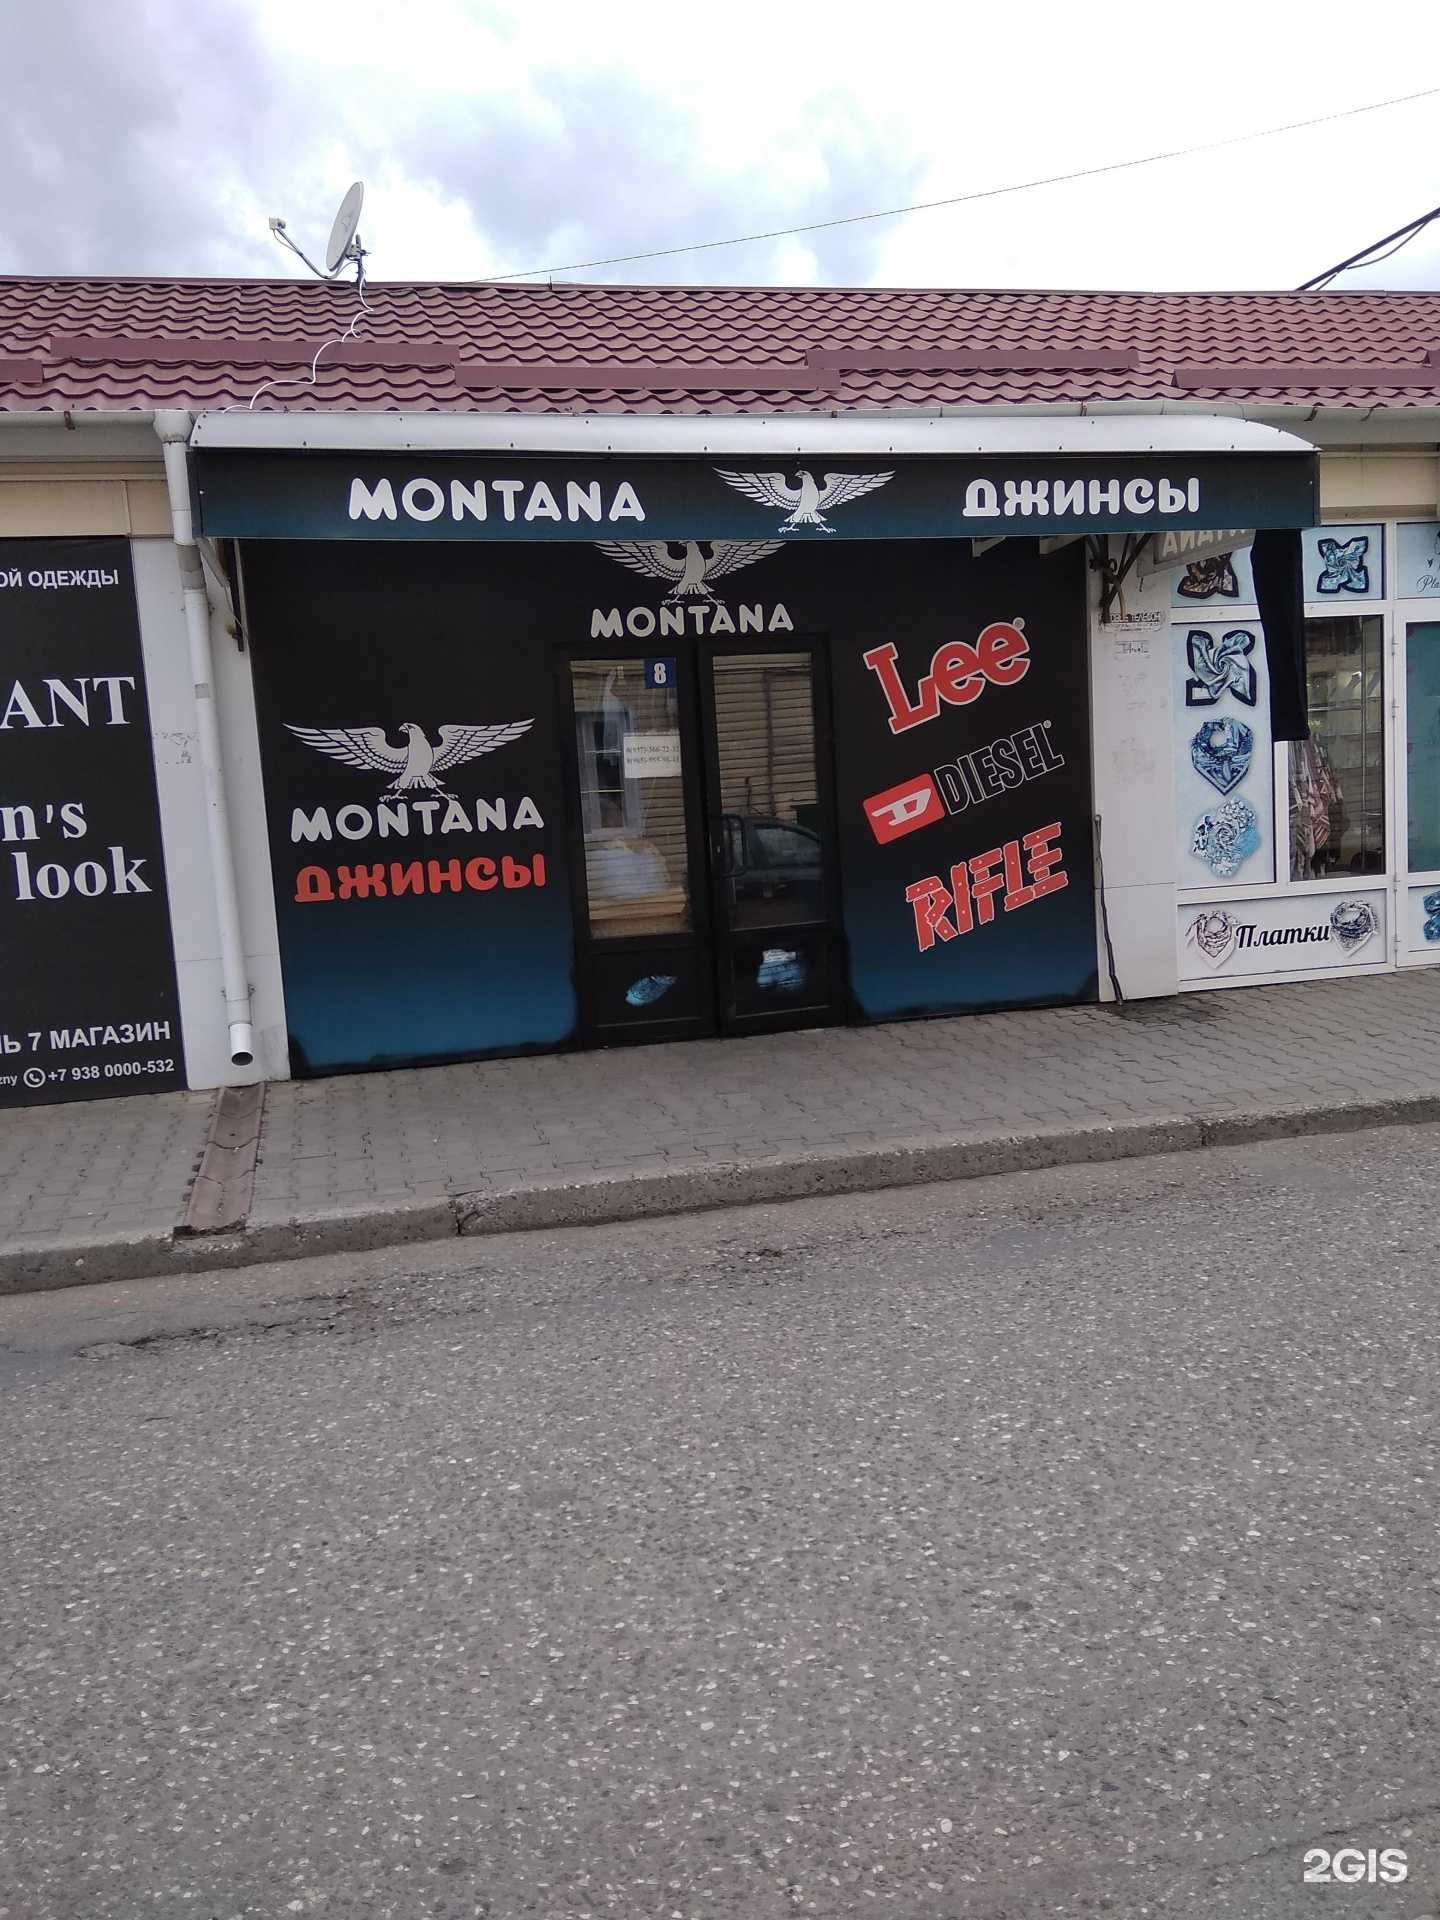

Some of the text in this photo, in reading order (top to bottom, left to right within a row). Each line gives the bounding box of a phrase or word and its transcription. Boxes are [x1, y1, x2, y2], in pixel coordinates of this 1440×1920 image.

[348, 478, 646, 522] MONTANA
[962, 477, 1200, 517] ДЖИНСЫ
[28, 569, 119, 589] ОДЕЖДЫ
[590, 603, 794, 639] MONTANA
[653, 662, 667, 684] 8
[863, 621, 1031, 735] Lee
[0, 677, 136, 729] ANT
[934, 723, 1065, 815] DIESEL
[0, 803, 88, 841] n's
[291, 797, 545, 842] MONTANA
[11, 846, 153, 900] look
[295, 853, 547, 903] ДЖИНСЫ
[905, 822, 1068, 953] RIFLE
[1236, 924, 1330, 949] Платки
[0, 1021, 170, 1054] Ь 7 МАГАЗИН
[48, 1058, 175, 1082] +7 938 0000-532
